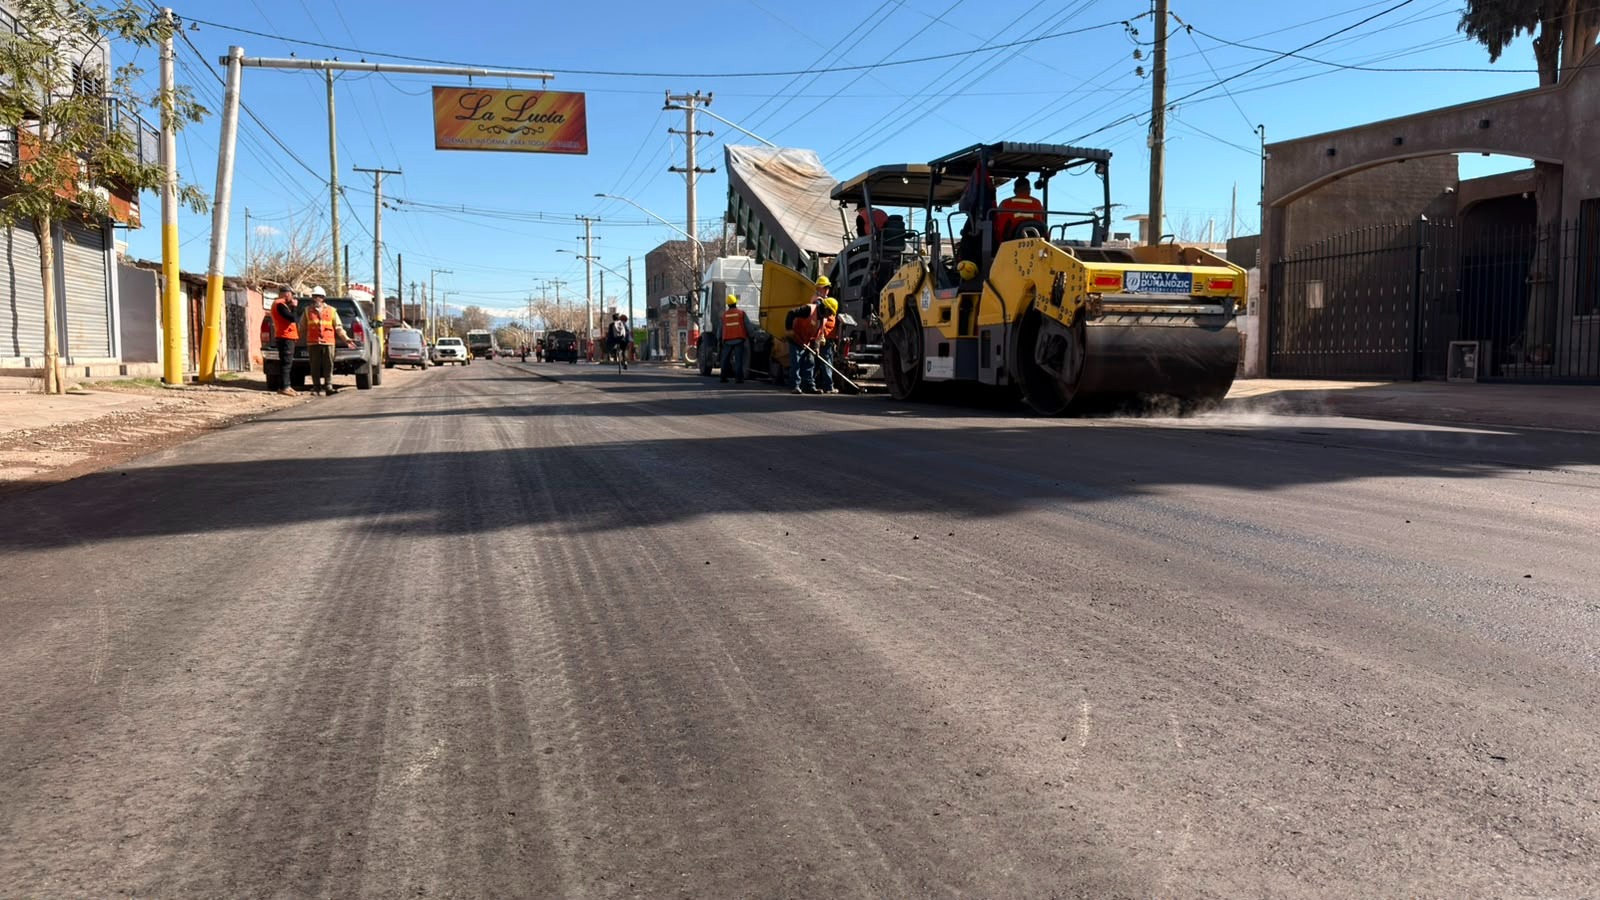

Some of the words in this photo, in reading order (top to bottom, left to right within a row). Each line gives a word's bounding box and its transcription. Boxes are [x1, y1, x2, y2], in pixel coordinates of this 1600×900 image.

[456, 93, 496, 121] La
[501, 95, 566, 124] Lucía
[1141, 272, 1163, 280] IVICA
